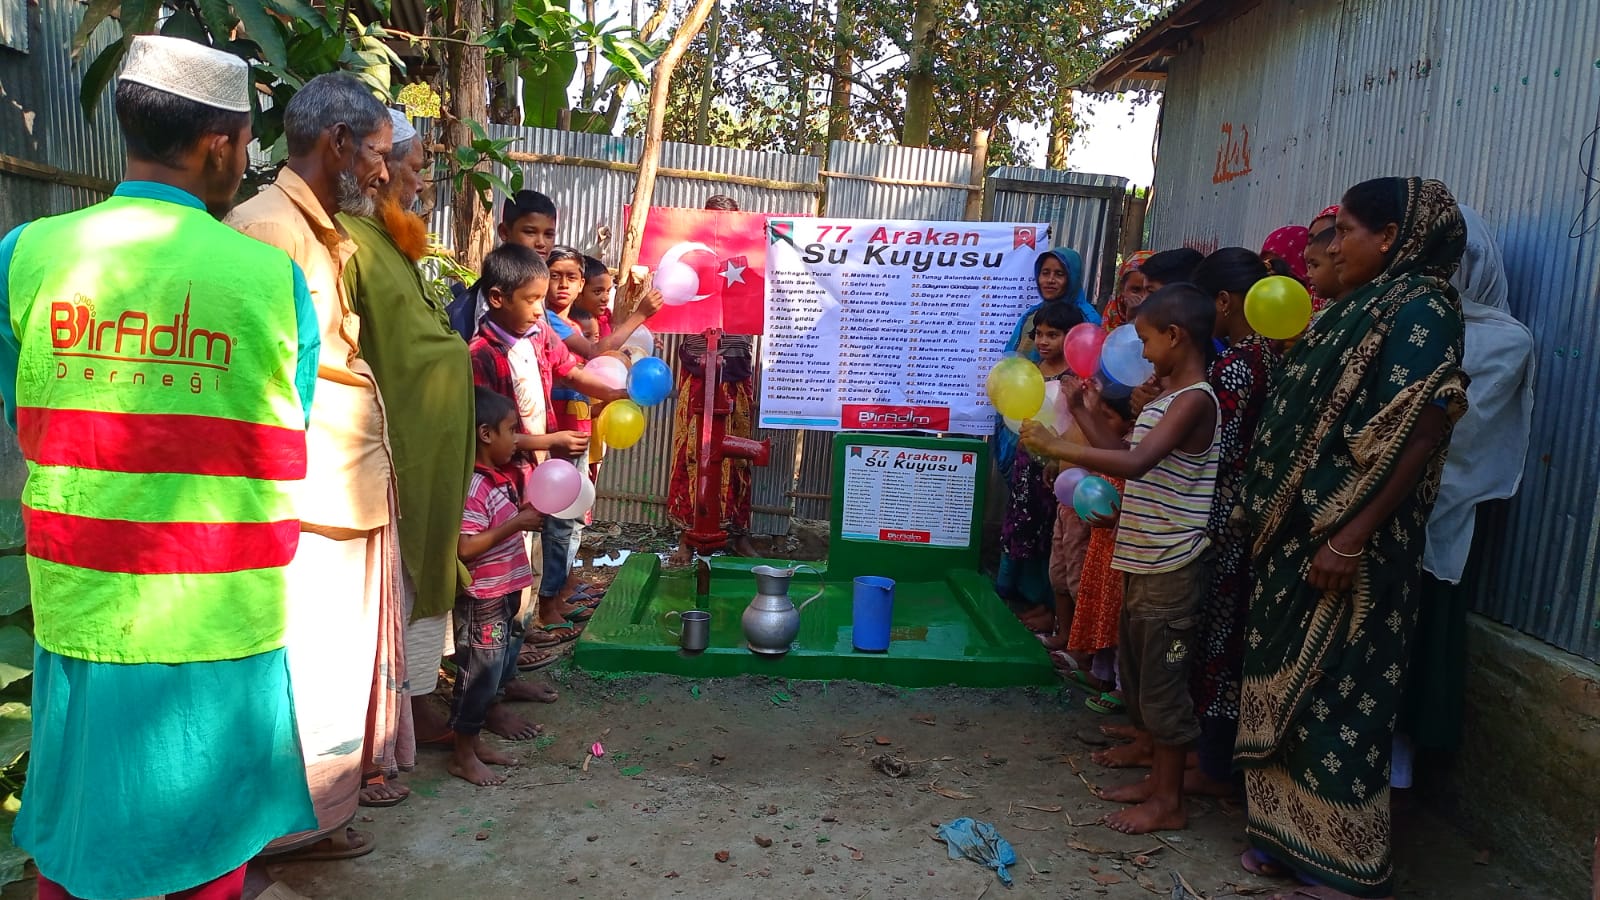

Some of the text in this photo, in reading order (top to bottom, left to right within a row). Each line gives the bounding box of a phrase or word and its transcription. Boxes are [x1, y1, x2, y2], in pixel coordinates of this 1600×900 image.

[816, 225, 981, 247] 77. Arakan
[802, 243, 1004, 273] Su Kuyusu
[57, 362, 219, 394] Derneği
[865, 458, 958, 473] Su Kuyusu
[872, 449, 947, 462] 77. Arakan
